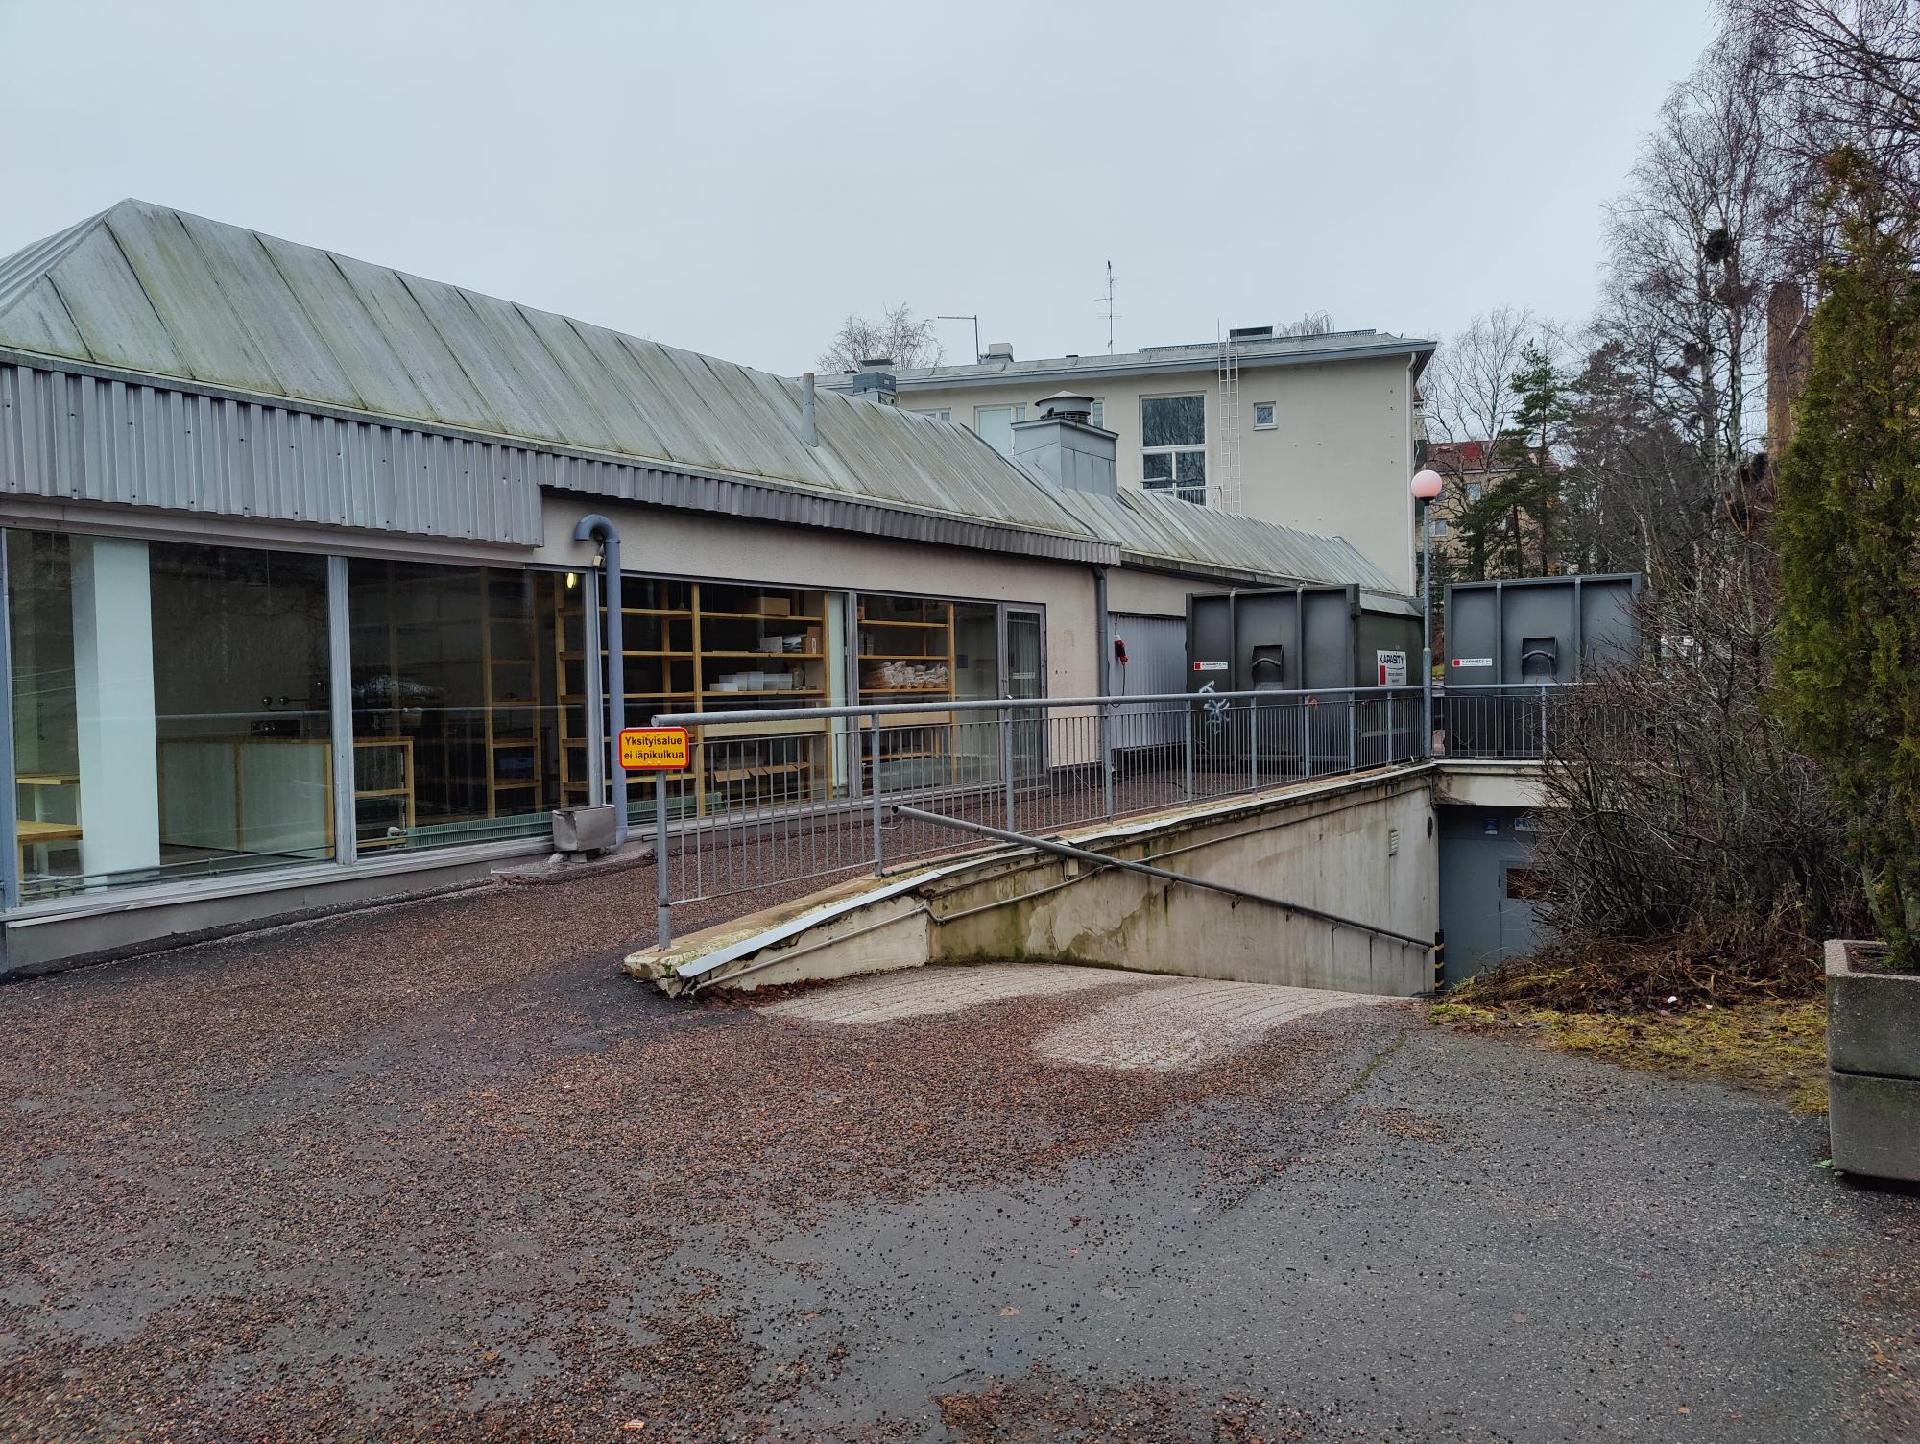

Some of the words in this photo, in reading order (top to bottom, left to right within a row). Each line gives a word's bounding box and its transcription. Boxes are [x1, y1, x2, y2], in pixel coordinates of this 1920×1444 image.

[625, 736, 683, 747] Yksityisalue
[624, 751, 633, 759] ei
[635, 750, 685, 760] läpikulkua
